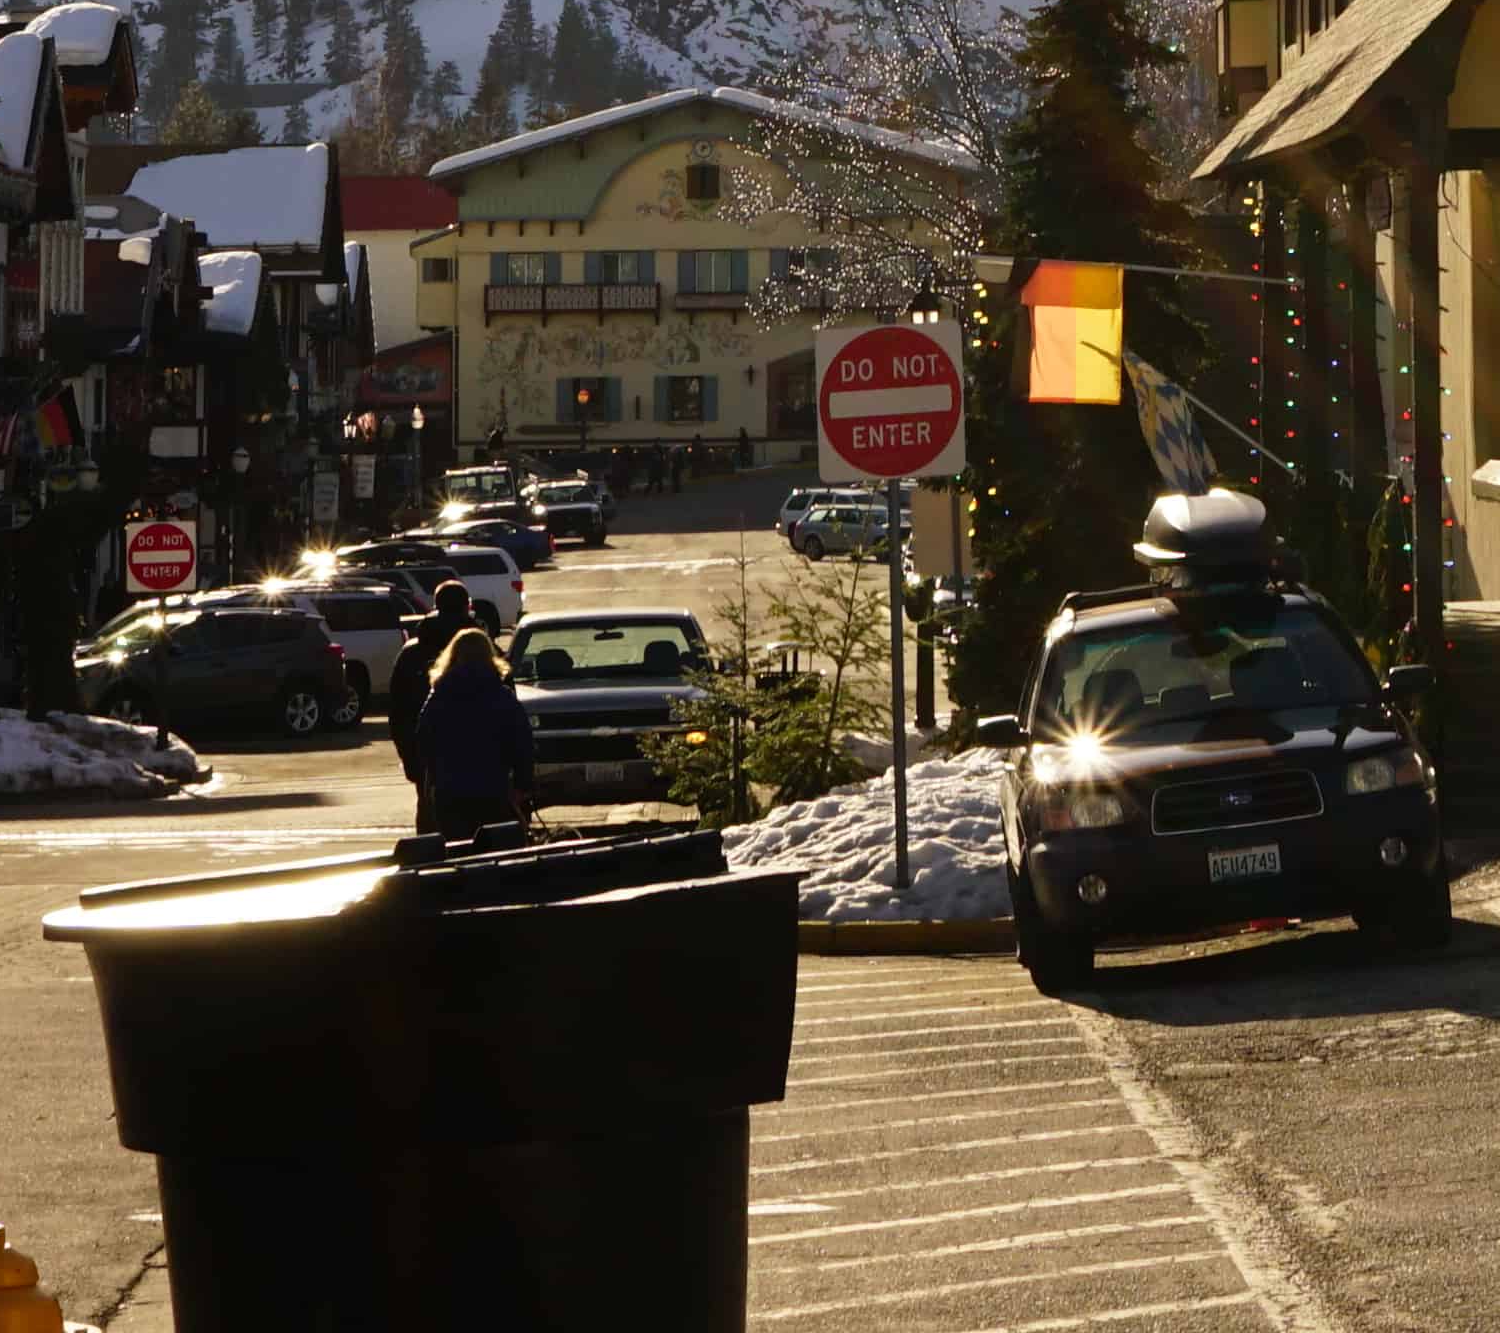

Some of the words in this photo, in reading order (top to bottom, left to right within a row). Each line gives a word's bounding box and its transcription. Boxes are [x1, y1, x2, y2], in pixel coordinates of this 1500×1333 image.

[841, 358, 874, 383] DO
[892, 354, 939, 380] NOT
[852, 421, 932, 450] ENTER
[138, 535, 155, 548] DO
[162, 534, 184, 547] NOT
[142, 565, 181, 579] ENTER
